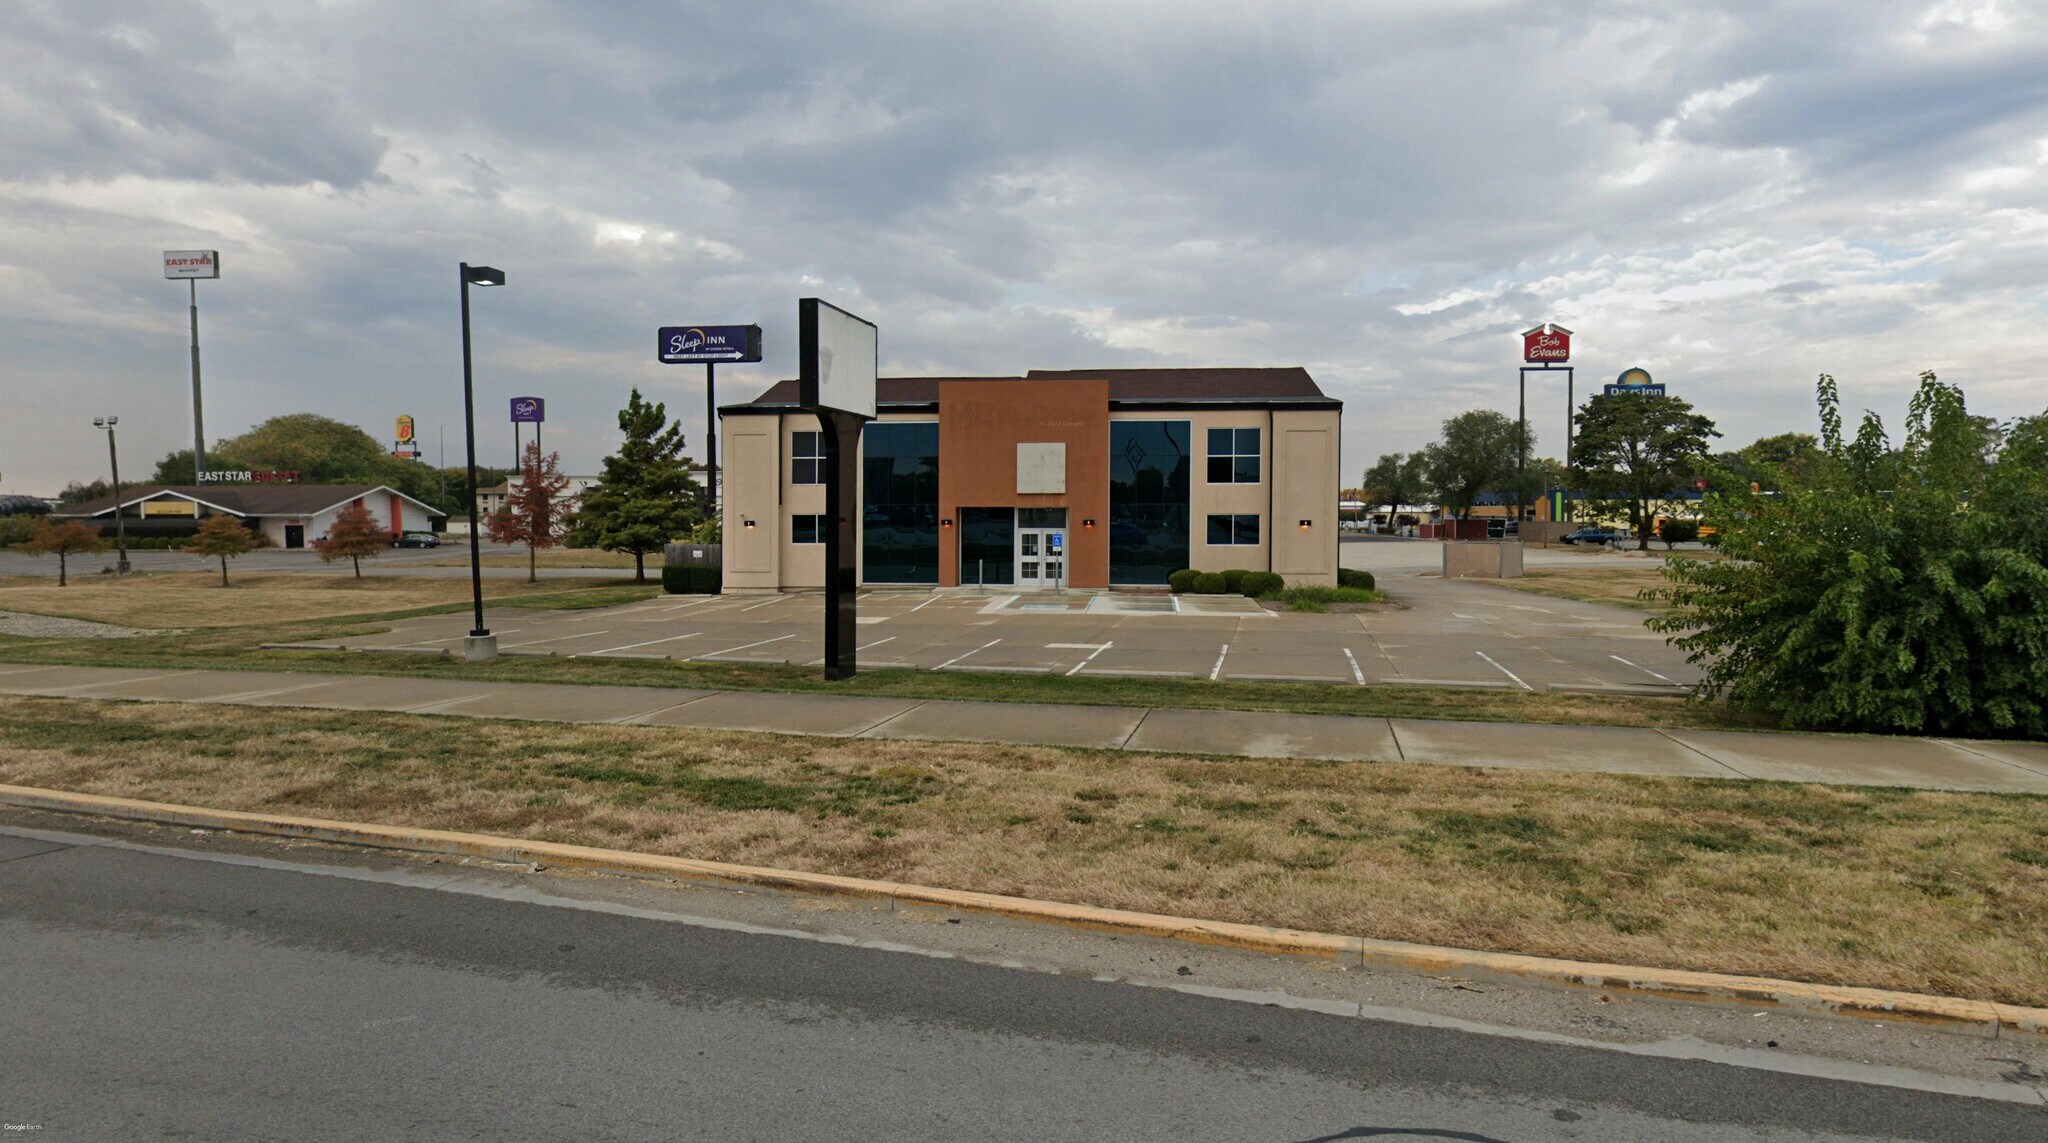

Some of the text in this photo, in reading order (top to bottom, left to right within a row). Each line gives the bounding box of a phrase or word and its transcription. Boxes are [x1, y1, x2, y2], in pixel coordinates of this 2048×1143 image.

[670, 334, 726, 354] Sleep INN
[1537, 335, 1560, 346] Bob
[1530, 345, 1567, 358] Evans
[1642, 387, 1663, 396] Inn
[516, 403, 534, 415] Sleep
[399, 424, 411, 439] 8
[198, 471, 224, 481] EAST
[225, 471, 252, 481] STAR
